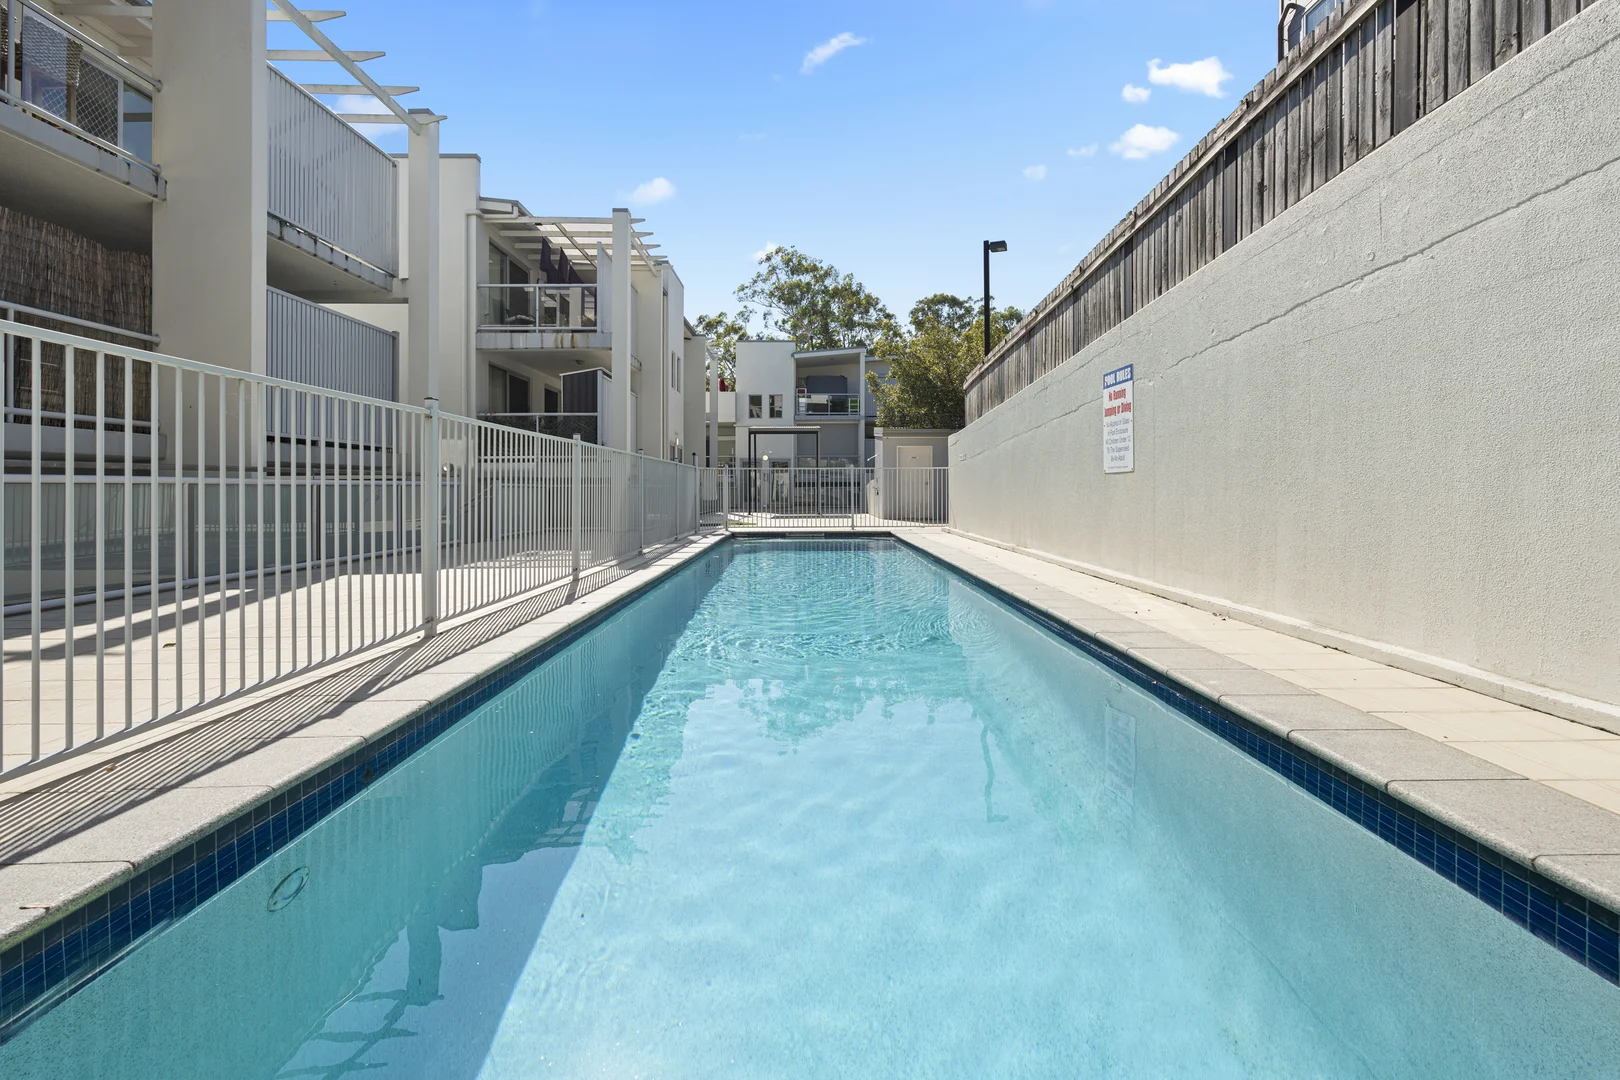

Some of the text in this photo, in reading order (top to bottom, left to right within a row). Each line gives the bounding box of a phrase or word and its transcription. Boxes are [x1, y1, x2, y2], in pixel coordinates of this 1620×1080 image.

[1104, 367, 1131, 386] POOL RULES
[1113, 388, 1126, 400] Running
